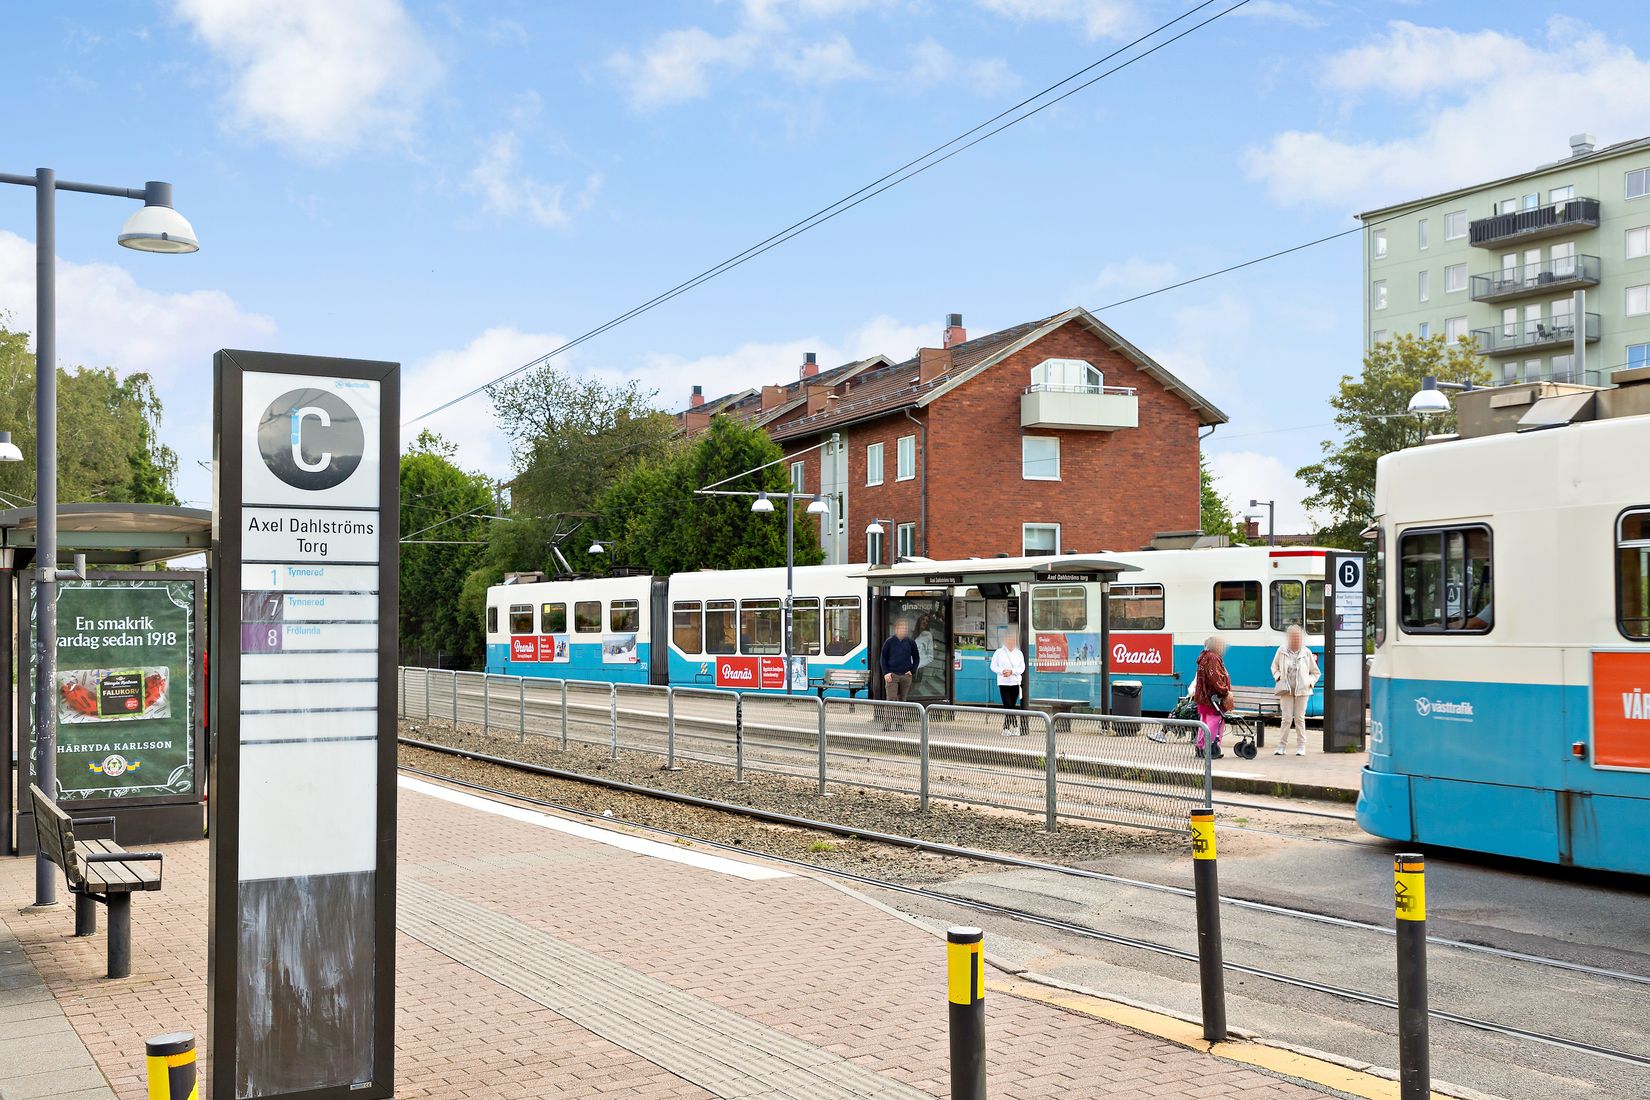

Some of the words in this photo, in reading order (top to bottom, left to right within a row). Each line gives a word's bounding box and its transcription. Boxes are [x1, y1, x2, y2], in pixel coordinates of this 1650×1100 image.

[291, 407, 332, 472] C
[248, 517, 283, 532] Axel
[290, 518, 374, 535] Dahlströms
[297, 538, 328, 556] Torg
[271, 569, 277, 586] 1
[287, 567, 324, 577] Tynnered
[1345, 565, 1354, 583] B
[269, 600, 278, 617] 7
[288, 597, 325, 607] Tynnered
[76, 617, 94, 630] En
[97, 616, 154, 630] smakrik
[102, 633, 143, 646] sedan
[147, 632, 177, 646] 1918
[267, 629, 278, 646] 8
[286, 626, 320, 635] Frölunda
[1113, 644, 1161, 664] Branäs
[722, 663, 752, 680] Branäs
[102, 689, 139, 697] FALUKORV
[1430, 700, 1474, 715] västtrafik
[57, 743, 111, 753] HÄRRYDA
[113, 740, 173, 752] KARLSSON
